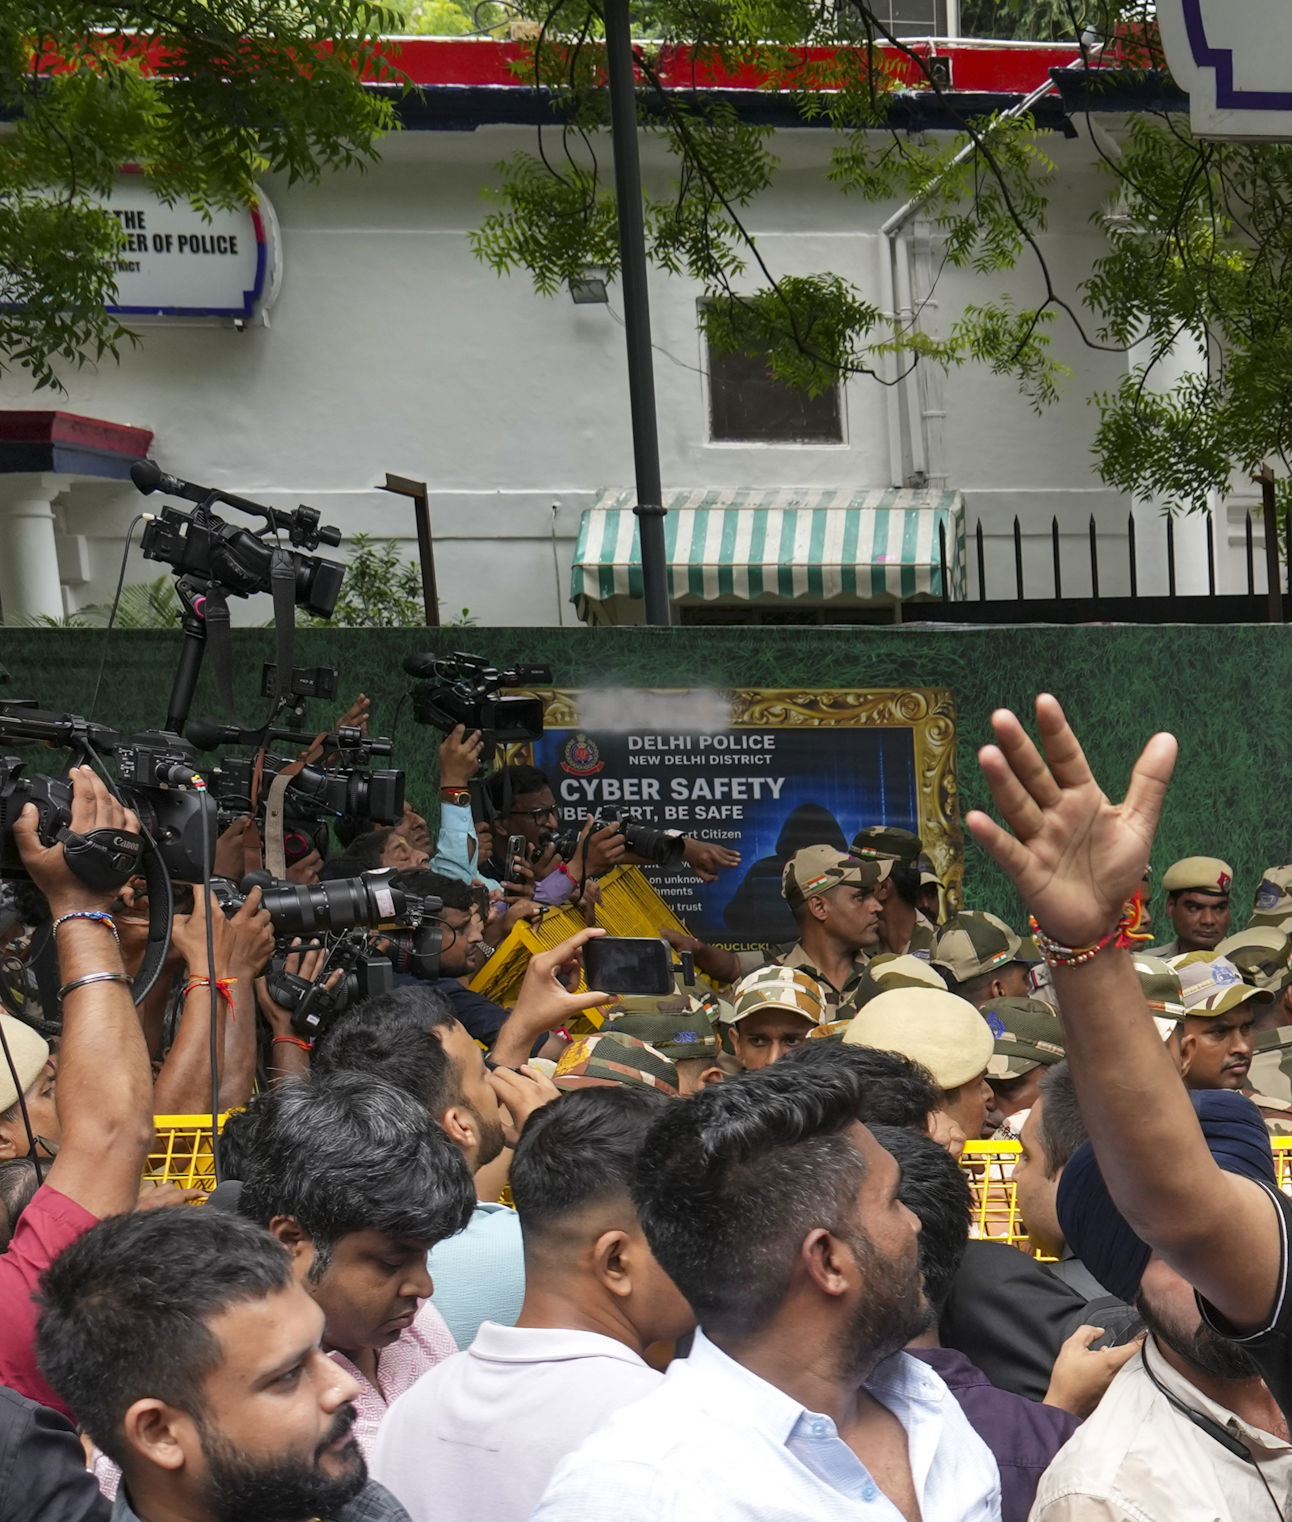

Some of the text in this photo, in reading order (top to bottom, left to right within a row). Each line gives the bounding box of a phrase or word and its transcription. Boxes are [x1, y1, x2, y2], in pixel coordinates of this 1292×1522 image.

[153, 233, 173, 253] OF
[177, 234, 239, 255] POLICE
[628, 735, 776, 750] DELHI POLICE
[629, 754, 773, 766] NEW DELHI DISTRICT
[560, 777, 786, 801] CYBER SAFETY
[664, 805, 692, 820] BE
[695, 805, 744, 820] SAFE
[701, 829, 742, 839] Citizen
[113, 836, 139, 851] Canon
[664, 875, 704, 884] unknow
[677, 902, 702, 912] trust
